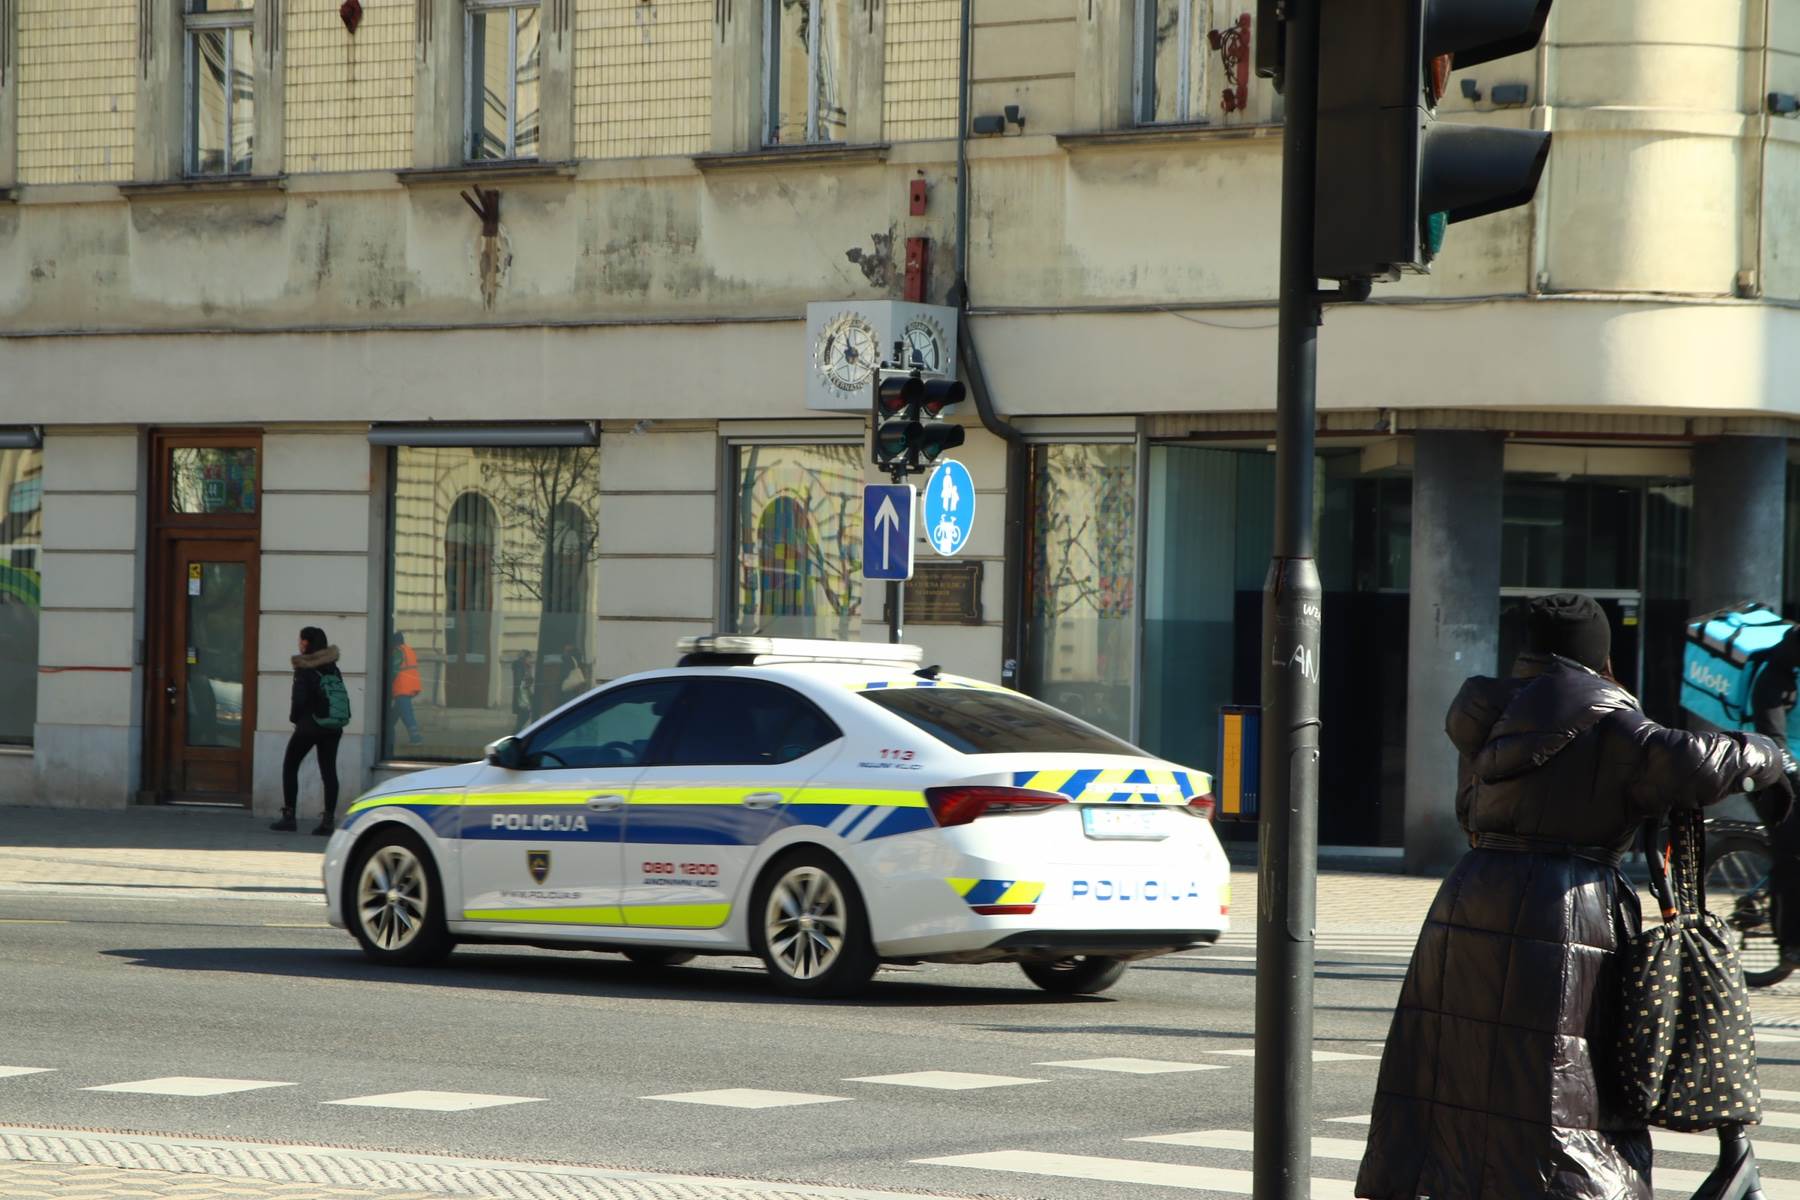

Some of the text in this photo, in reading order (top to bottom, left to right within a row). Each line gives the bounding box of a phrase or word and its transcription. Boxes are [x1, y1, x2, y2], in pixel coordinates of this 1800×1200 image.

[1691, 661, 1729, 696] Wolt
[880, 749, 914, 760] 113
[491, 813, 589, 831] POLICIJA
[642, 862, 719, 876] 080 1200
